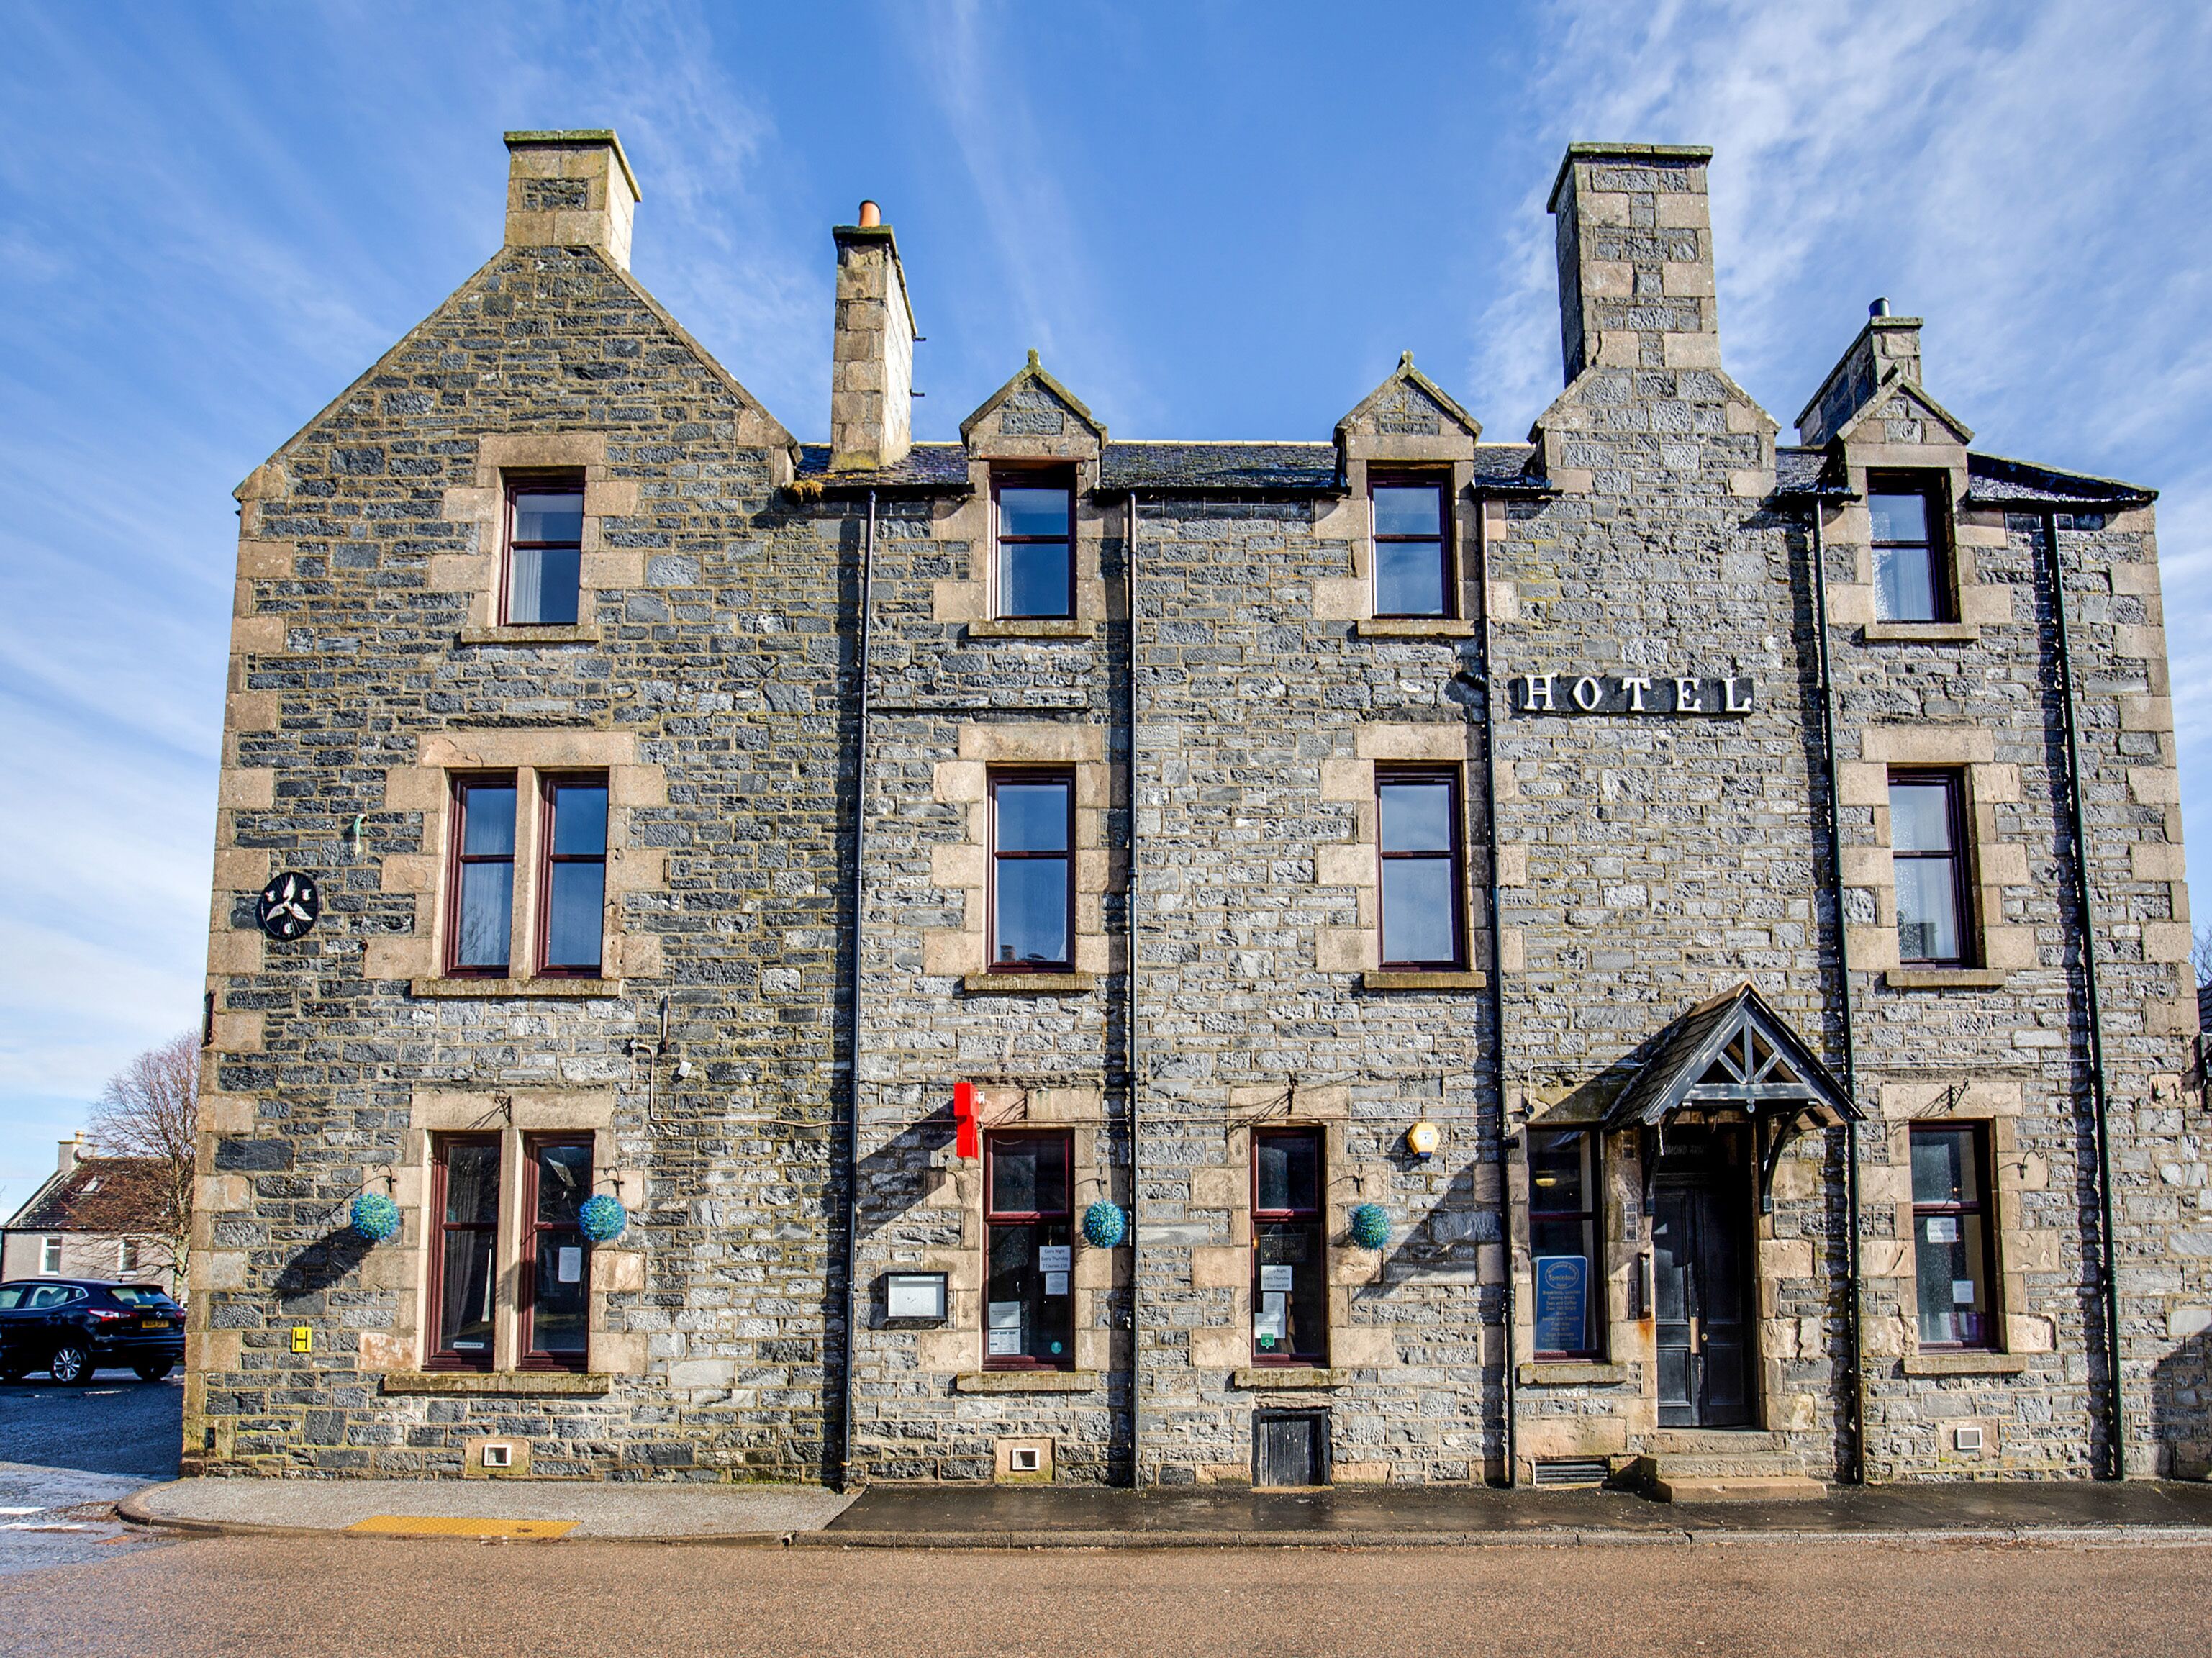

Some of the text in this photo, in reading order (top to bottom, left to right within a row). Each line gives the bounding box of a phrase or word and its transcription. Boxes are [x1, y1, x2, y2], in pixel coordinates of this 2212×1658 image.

[1524, 672, 1752, 712] HOTEL
[1272, 1241, 1295, 1249] OPEN
[294, 1331, 308, 1350] H
